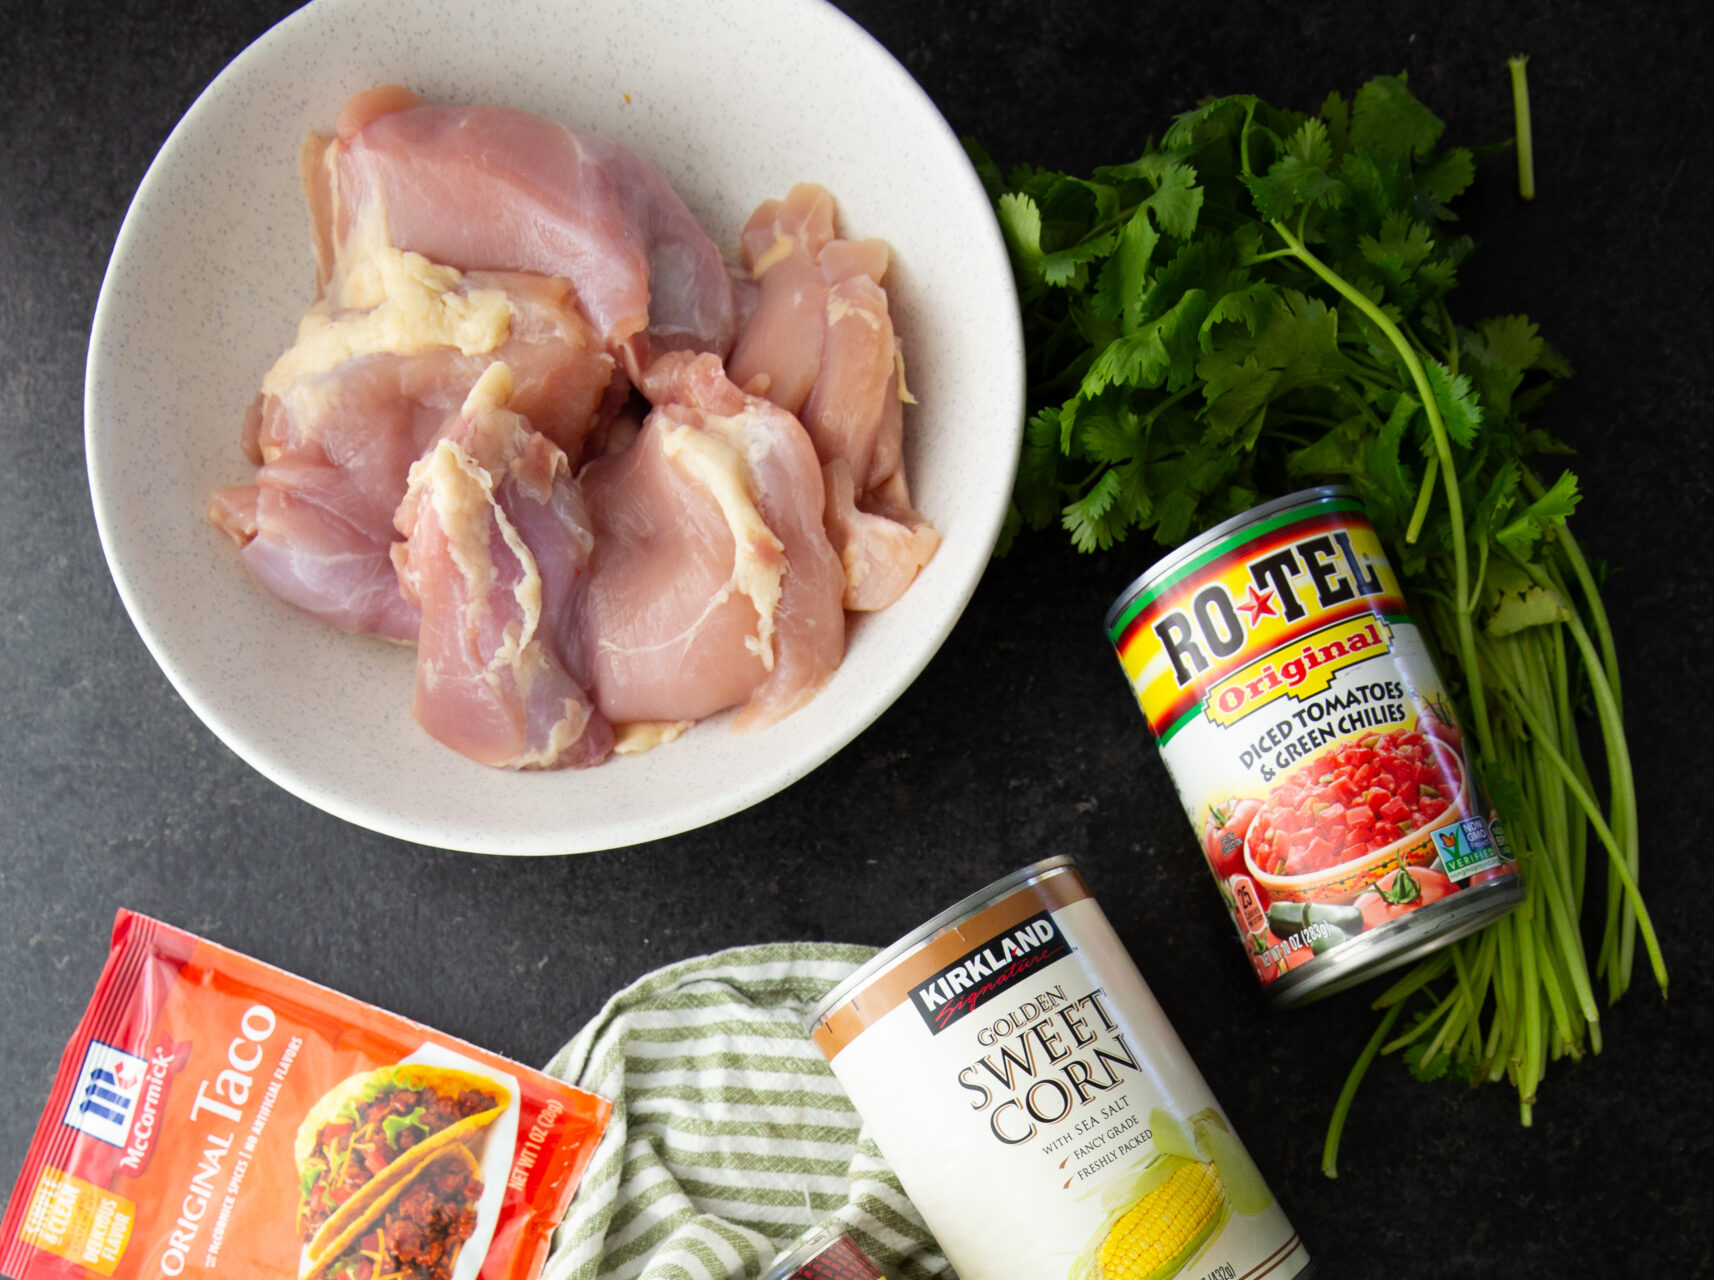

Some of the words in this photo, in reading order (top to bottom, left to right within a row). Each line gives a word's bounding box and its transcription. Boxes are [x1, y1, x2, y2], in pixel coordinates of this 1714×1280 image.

[1218, 624, 1383, 713] Original
[1239, 720, 1293, 770] DICED
[1292, 682, 1404, 728] TOMATOES
[1260, 764, 1276, 782] &
[1276, 722, 1336, 769] GREEN
[1338, 703, 1406, 734] CHILIES
[1448, 848, 1496, 870] VERIFIED
[1466, 828, 1487, 841] GMO
[1238, 885, 1253, 909] 25
[919, 919, 1055, 1012] KIRKLAND
[1289, 933, 1303, 951] OZ
[1301, 920, 1332, 947] (283g)
[935, 946, 1065, 1029] Signature
[977, 985, 1069, 1047] GOLDEN
[189, 1005, 276, 1123] Taco
[958, 987, 1118, 1112] SWEET
[120, 1053, 175, 1170] McCormick
[227, 1160, 248, 1195] SPICES
[243, 1135, 259, 1152] NO
[252, 1081, 282, 1135] ARTIFICIAL
[273, 1035, 303, 1081] FLAVORS
[990, 1033, 1143, 1146] CORN
[525, 1141, 542, 1150] 1
[528, 1125, 549, 1143] OZ
[1042, 1132, 1073, 1155] WITH
[1074, 1116, 1100, 1136] SEA
[1101, 1095, 1130, 1120] SALT
[1073, 1134, 1106, 1160] FANCY
[1106, 1114, 1140, 1140] GRADE
[1077, 1149, 1118, 1180] FRESHLY
[1118, 1129, 1153, 1156] PACKED
[508, 1166, 529, 1191] NET
[516, 1147, 538, 1168] WT
[48, 1183, 80, 1234] CLEAN
[83, 1198, 117, 1264] DELICIOUS
[160, 1132, 234, 1277] ORIGINAL
[101, 1212, 130, 1262] FLAVOR
